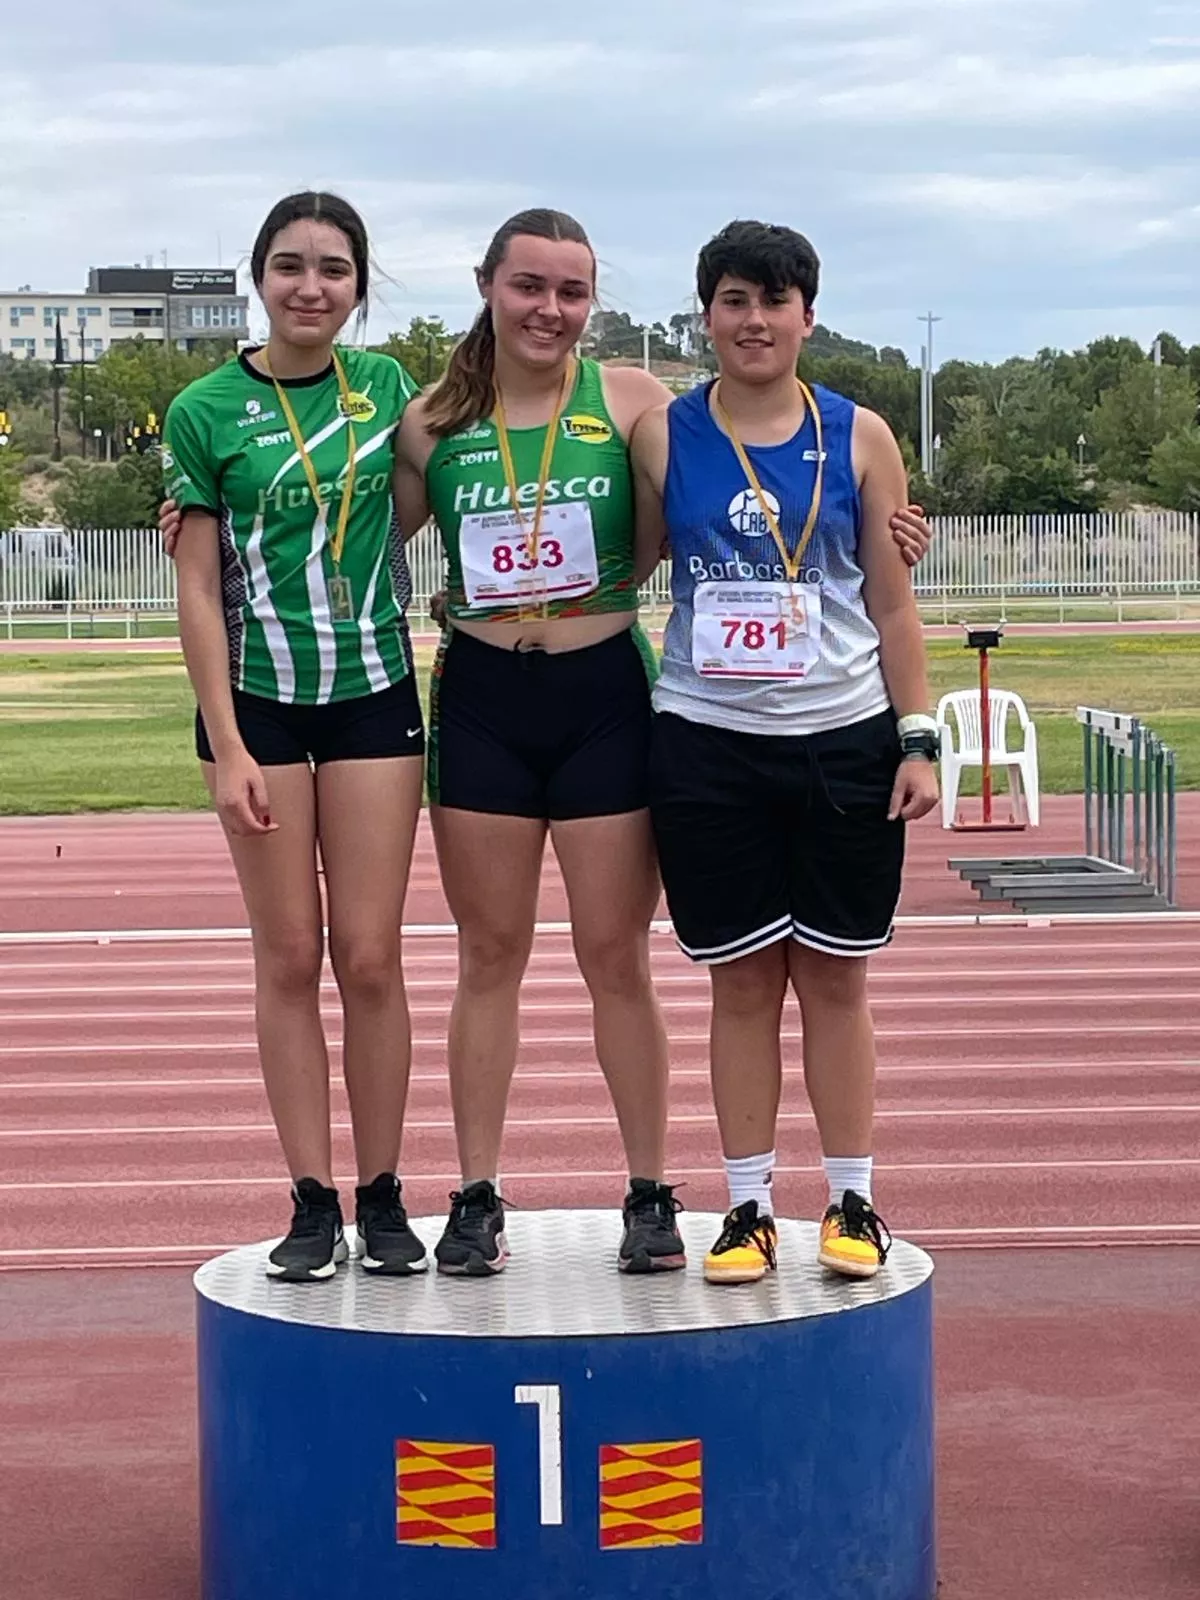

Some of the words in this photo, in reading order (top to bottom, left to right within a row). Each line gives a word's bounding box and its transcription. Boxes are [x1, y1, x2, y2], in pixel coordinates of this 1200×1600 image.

[257, 473, 388, 513] Huesca
[453, 476, 612, 512] Huesca
[492, 540, 565, 574] 833
[689, 551, 823, 584] Barbasro
[720, 620, 787, 651] 781
[514, 1385, 562, 1525] 1
